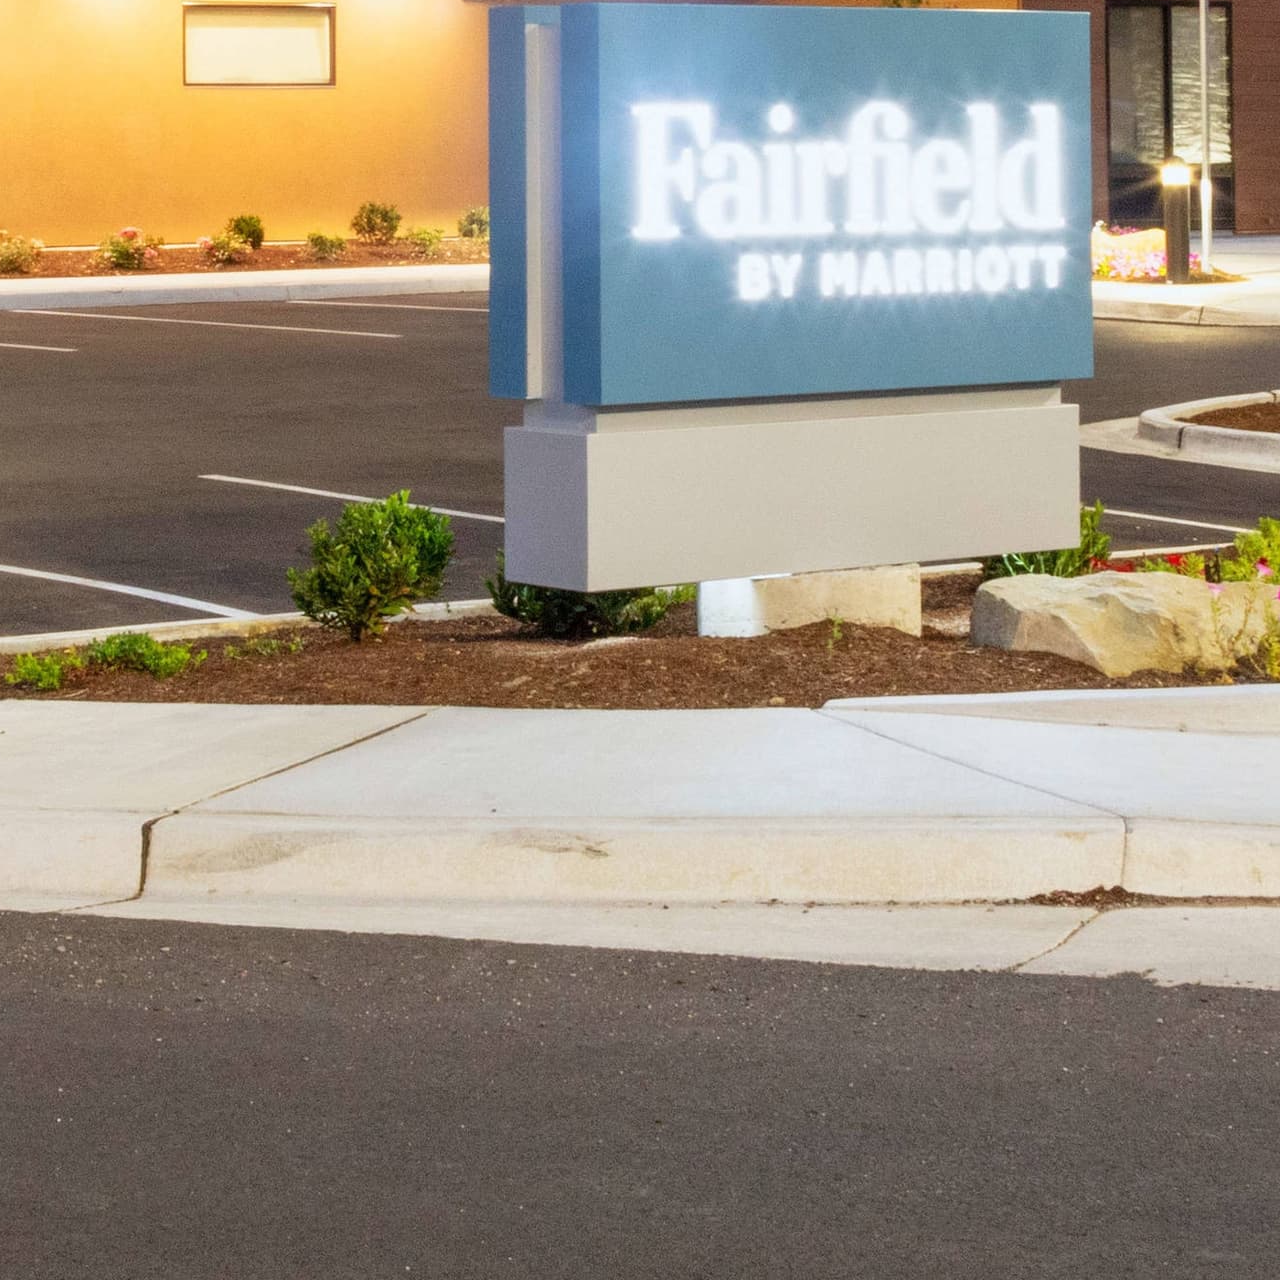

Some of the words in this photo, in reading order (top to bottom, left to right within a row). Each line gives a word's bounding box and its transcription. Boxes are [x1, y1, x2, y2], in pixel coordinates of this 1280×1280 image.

[631, 102, 1066, 240] Fairfield
[738, 252, 802, 301] BY
[819, 246, 1066, 296] MARRIOTT
